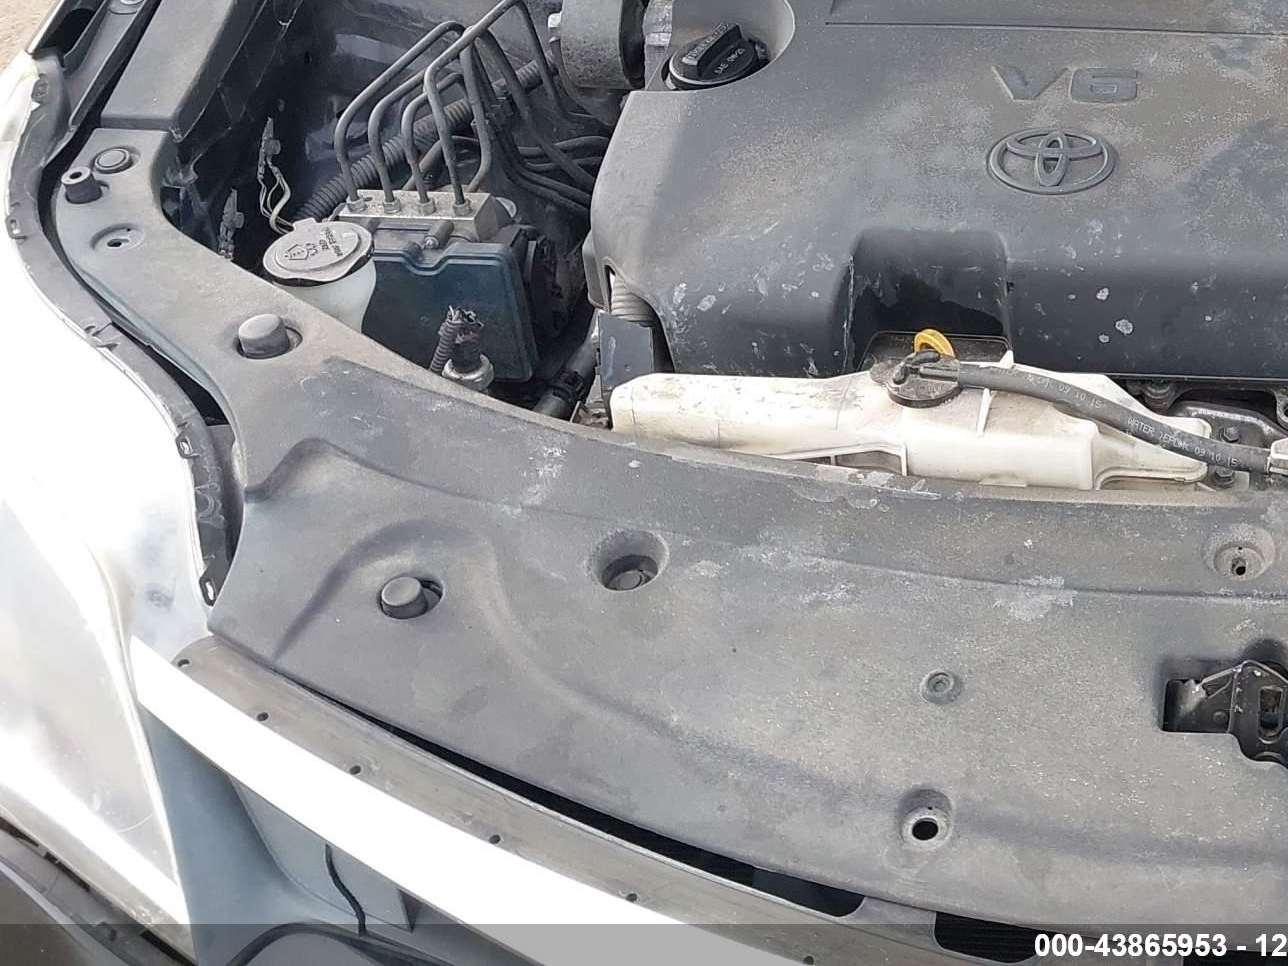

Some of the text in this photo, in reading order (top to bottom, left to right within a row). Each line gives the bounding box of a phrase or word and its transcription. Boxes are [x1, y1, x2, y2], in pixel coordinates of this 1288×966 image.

[990, 65, 1139, 104] V6
[1127, 416, 1156, 436] WATER
[1194, 446, 1206, 457] 09
[1226, 456, 1239, 467] 15
